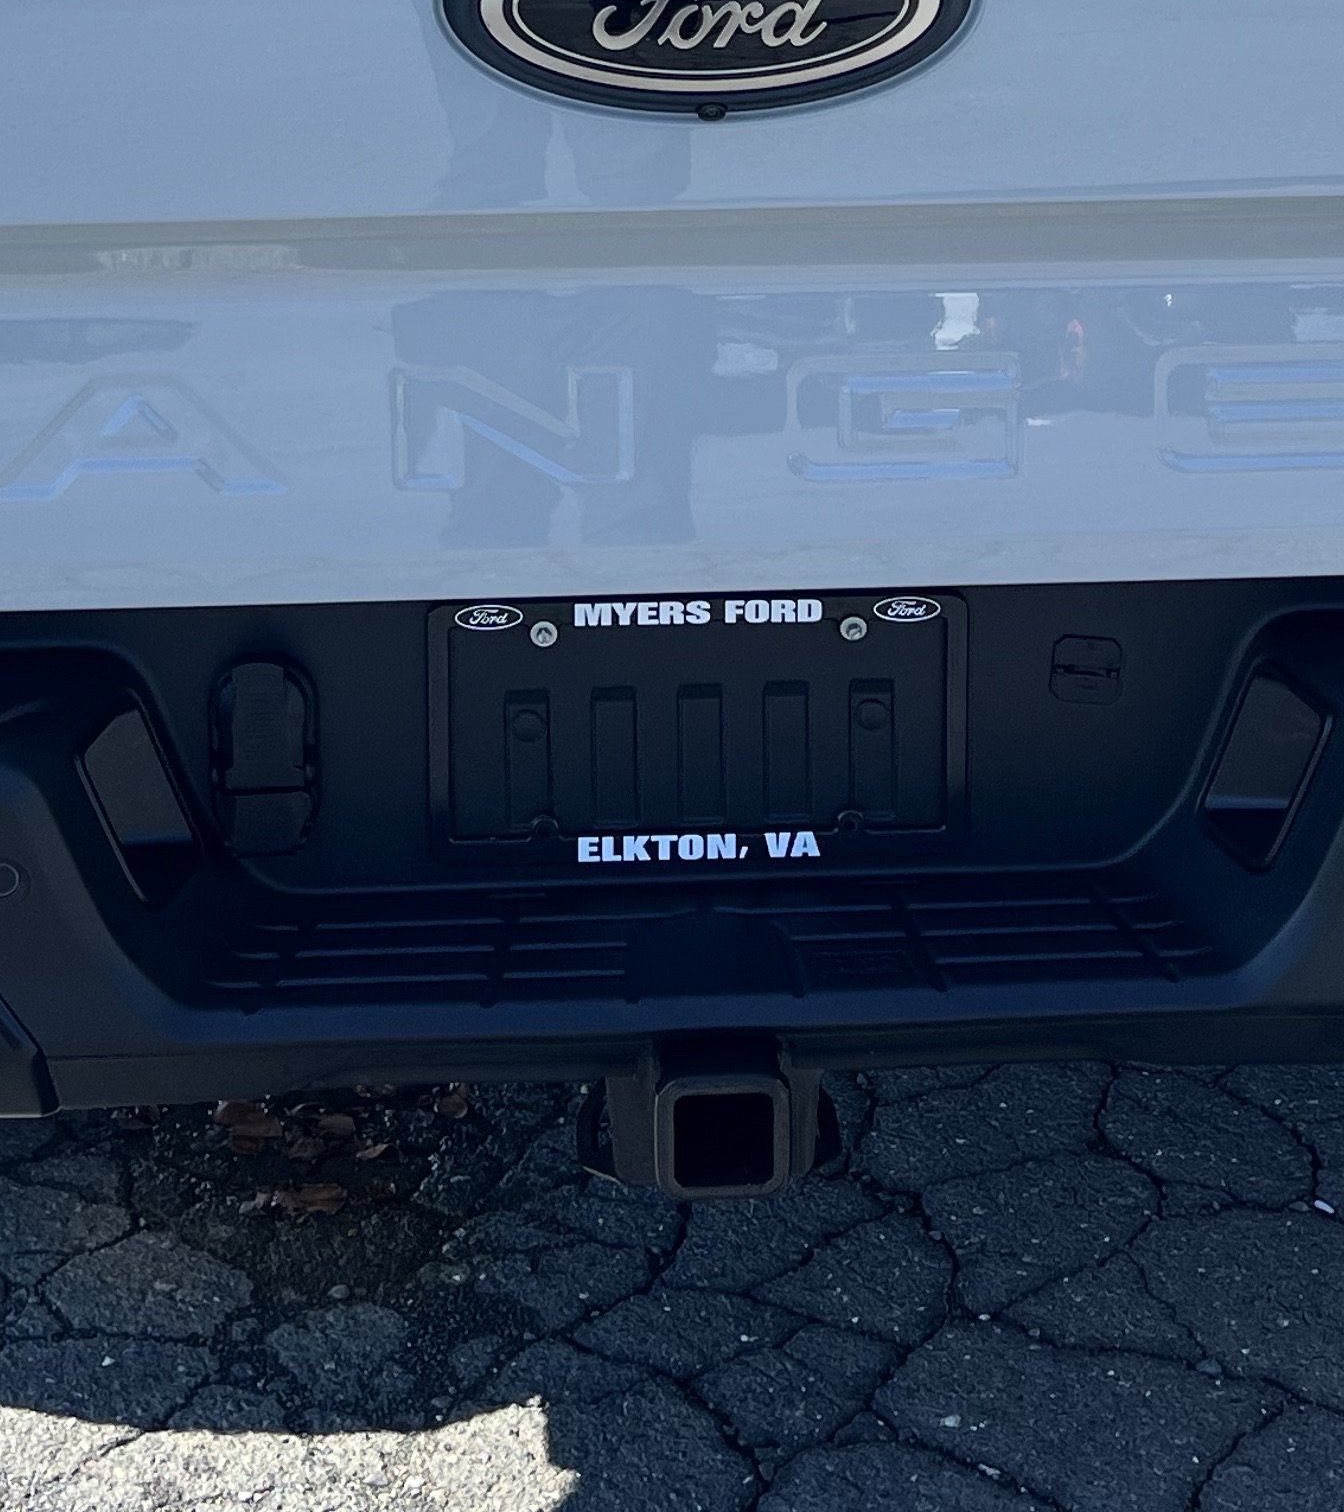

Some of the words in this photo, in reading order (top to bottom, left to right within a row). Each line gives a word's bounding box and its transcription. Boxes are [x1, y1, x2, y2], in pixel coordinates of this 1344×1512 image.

[467, 607, 509, 628] Ford
[572, 599, 712, 627] MYERS
[724, 597, 824, 624] FORD
[886, 599, 929, 619] Ford
[576, 832, 750, 863] ELKTON,
[763, 830, 821, 859] VA
